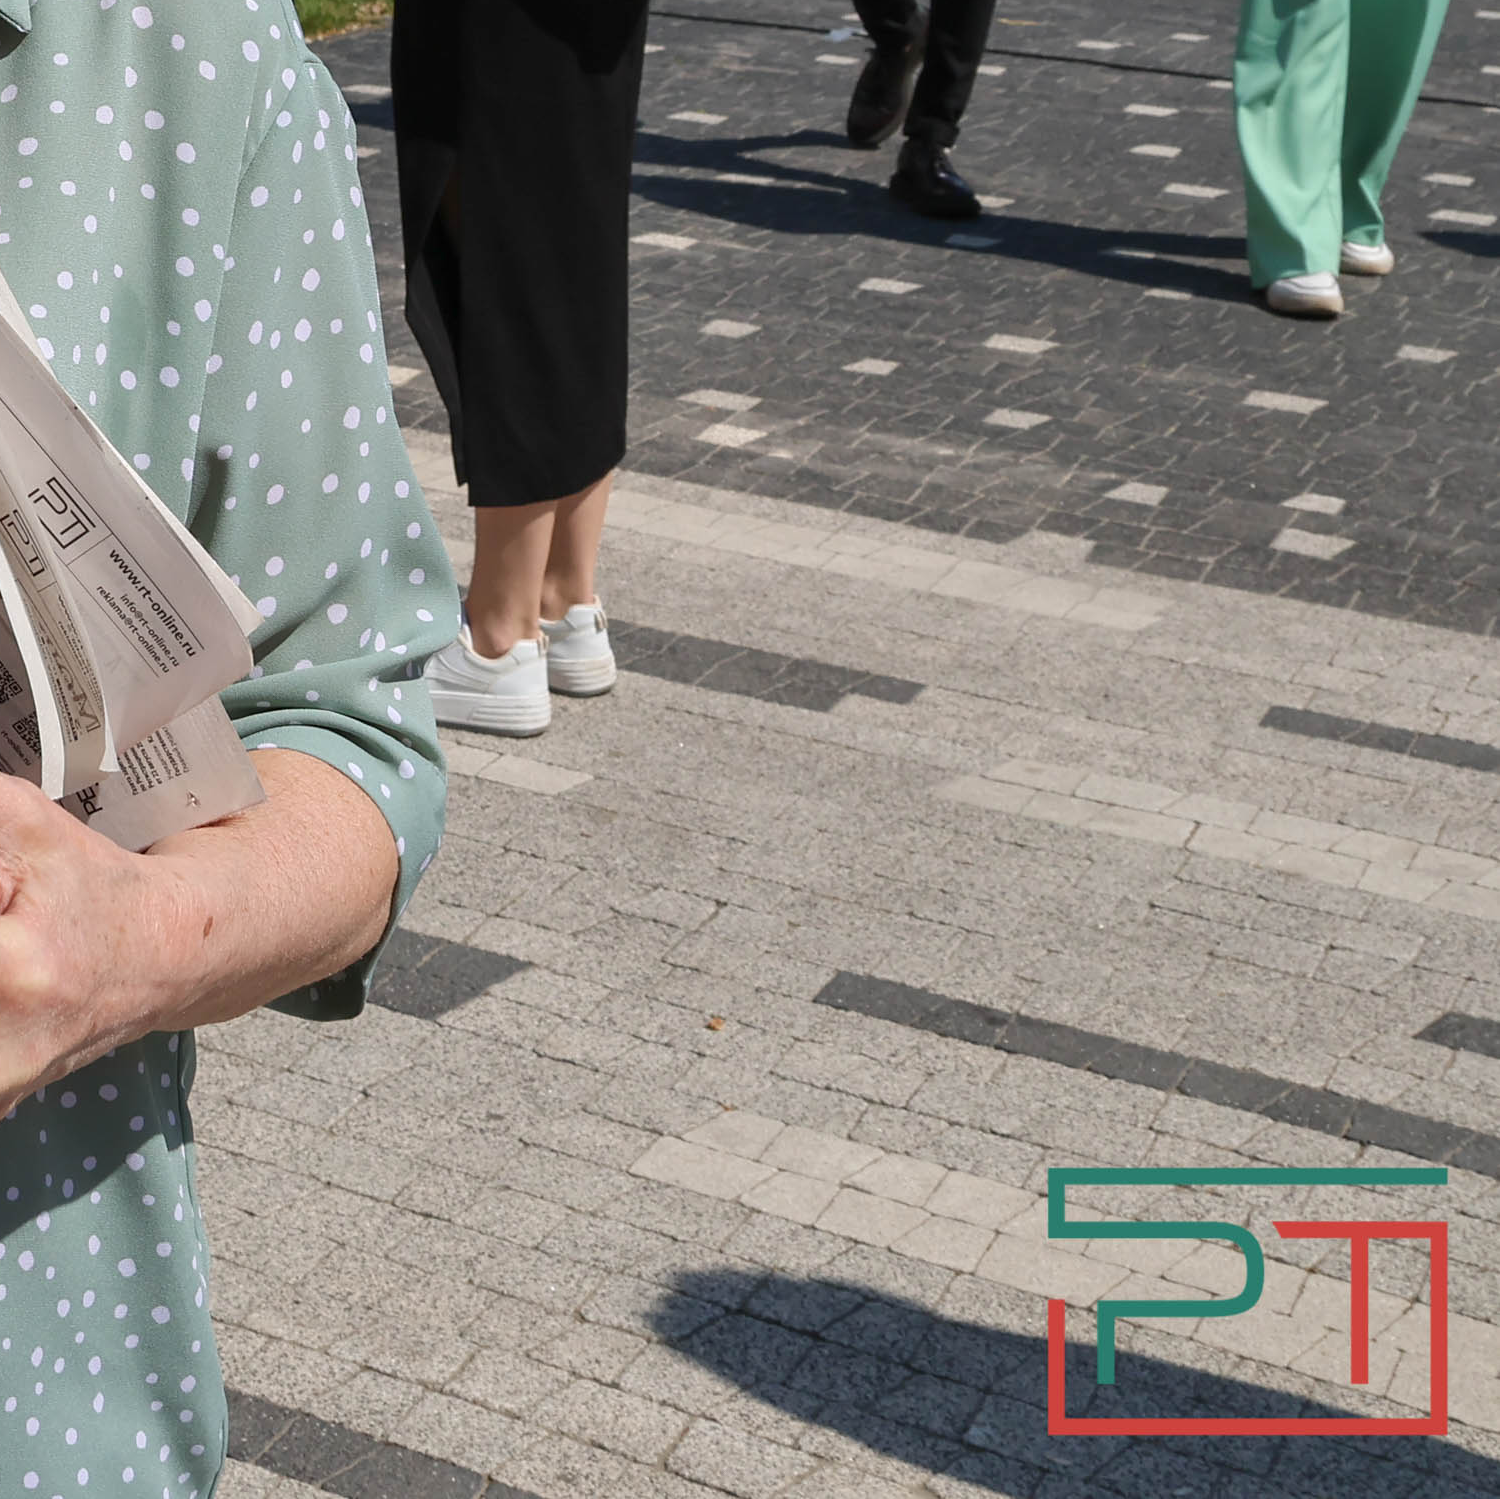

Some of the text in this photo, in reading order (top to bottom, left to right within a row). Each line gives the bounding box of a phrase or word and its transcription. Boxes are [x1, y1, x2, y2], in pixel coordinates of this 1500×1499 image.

[96, 584, 170, 674] reklama@rt-online.ru
[108, 547, 199, 658] www.rt-online.ru
[119, 592, 181, 667] info@rt-online.ru
